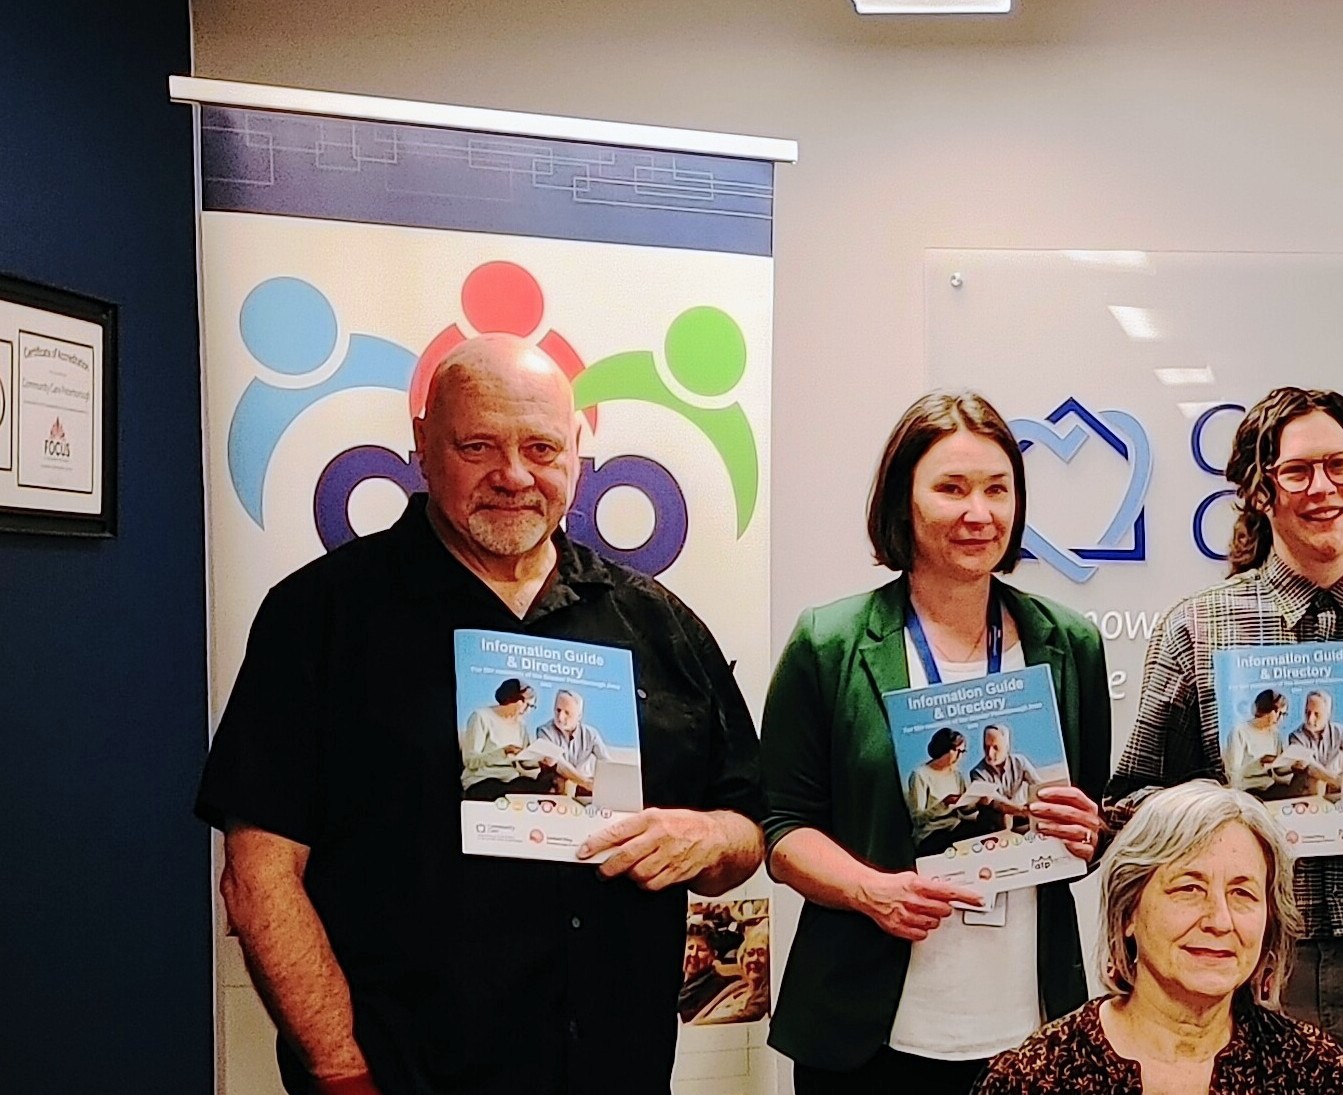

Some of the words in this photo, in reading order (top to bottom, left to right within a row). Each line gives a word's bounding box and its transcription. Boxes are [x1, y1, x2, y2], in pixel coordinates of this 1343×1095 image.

[44, 439, 70, 457] FOCUS
[481, 637, 562, 662] Information
[564, 650, 605, 667] Guide
[1236, 650, 1311, 668] Information
[506, 656, 518, 669] &
[521, 657, 584, 680] Directory
[1260, 668, 1271, 680] &
[1273, 665, 1332, 680] Directory
[908, 687, 984, 711] Information
[985, 677, 1024, 695] Guide
[933, 707, 946, 721] &
[947, 697, 1006, 720] Directory
